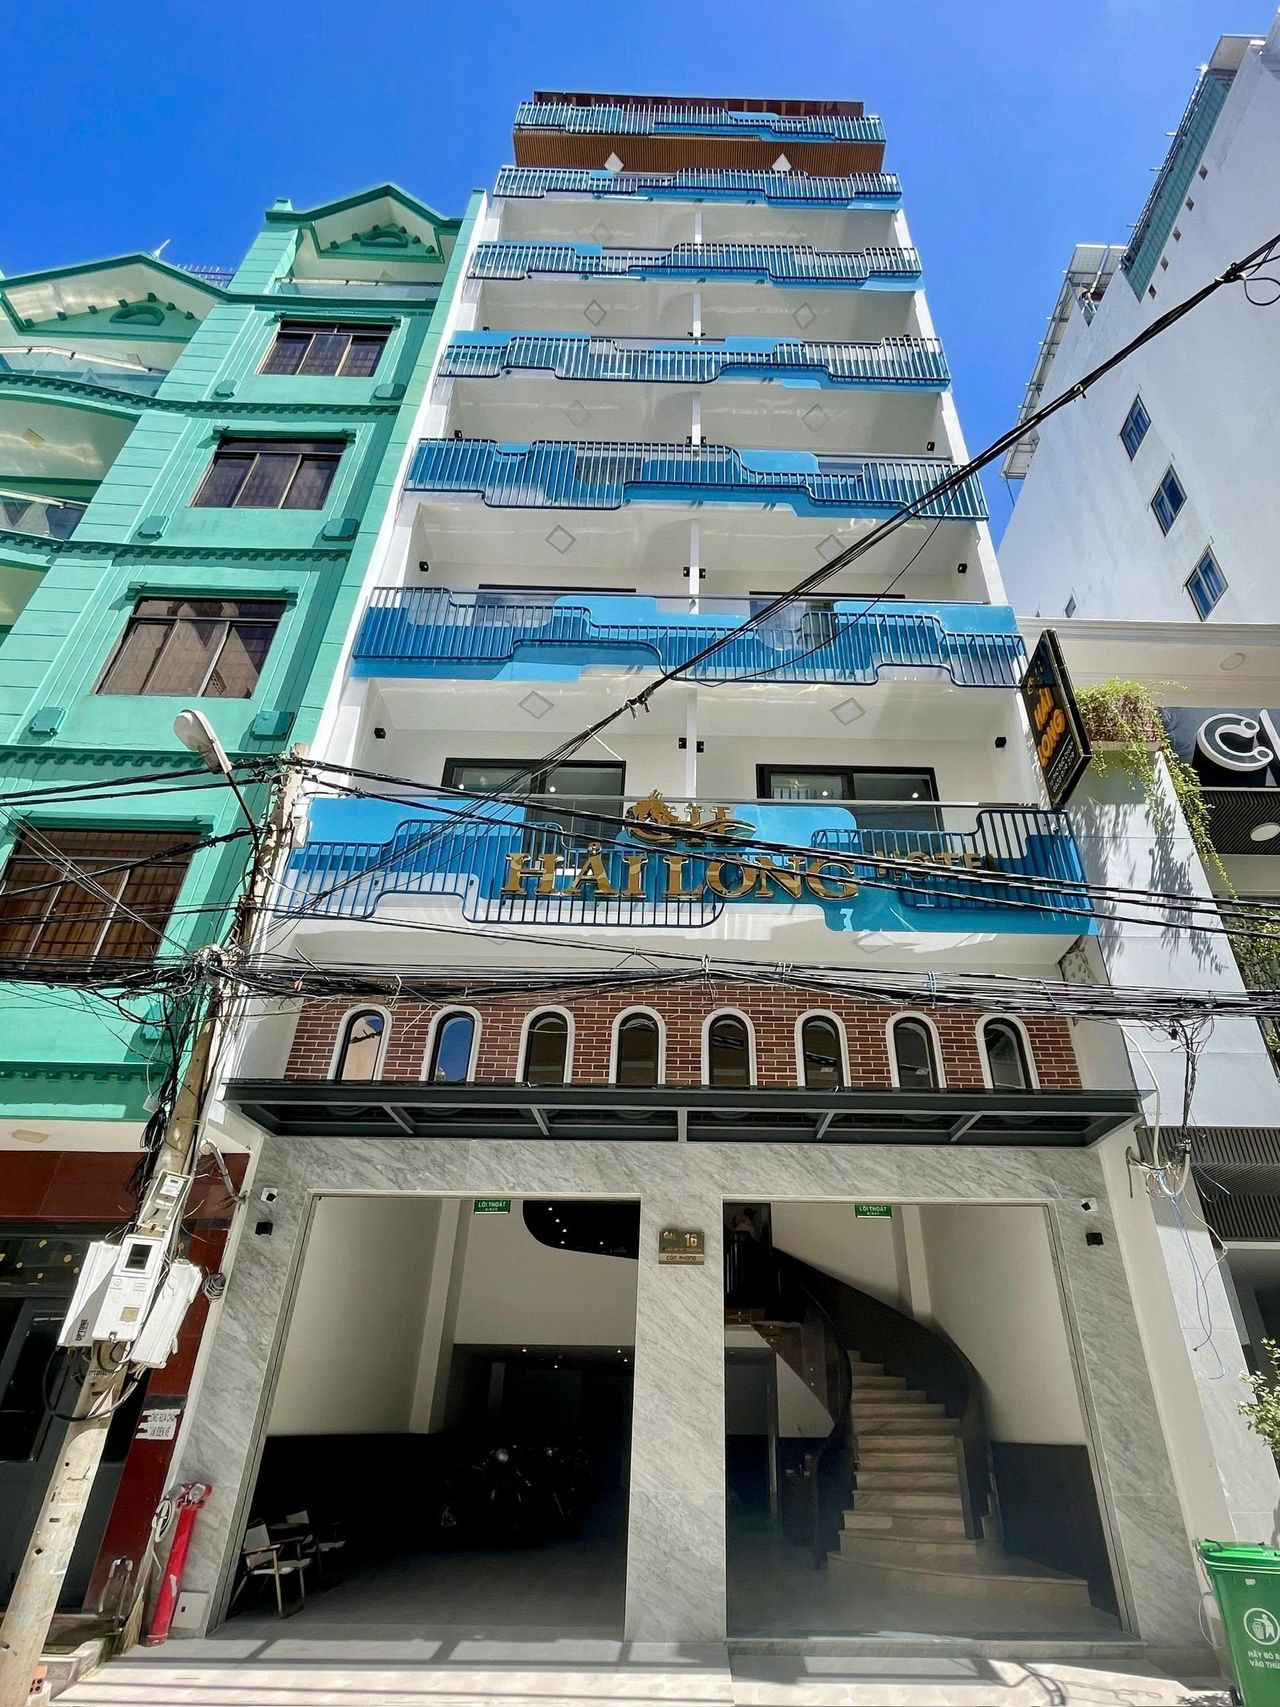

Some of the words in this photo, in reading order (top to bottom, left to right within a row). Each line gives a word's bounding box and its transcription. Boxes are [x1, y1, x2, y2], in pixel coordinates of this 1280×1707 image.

[1037, 709, 1066, 767] LONG
[662, 855, 859, 900] LONG
[684, 1233, 698, 1247] 16
